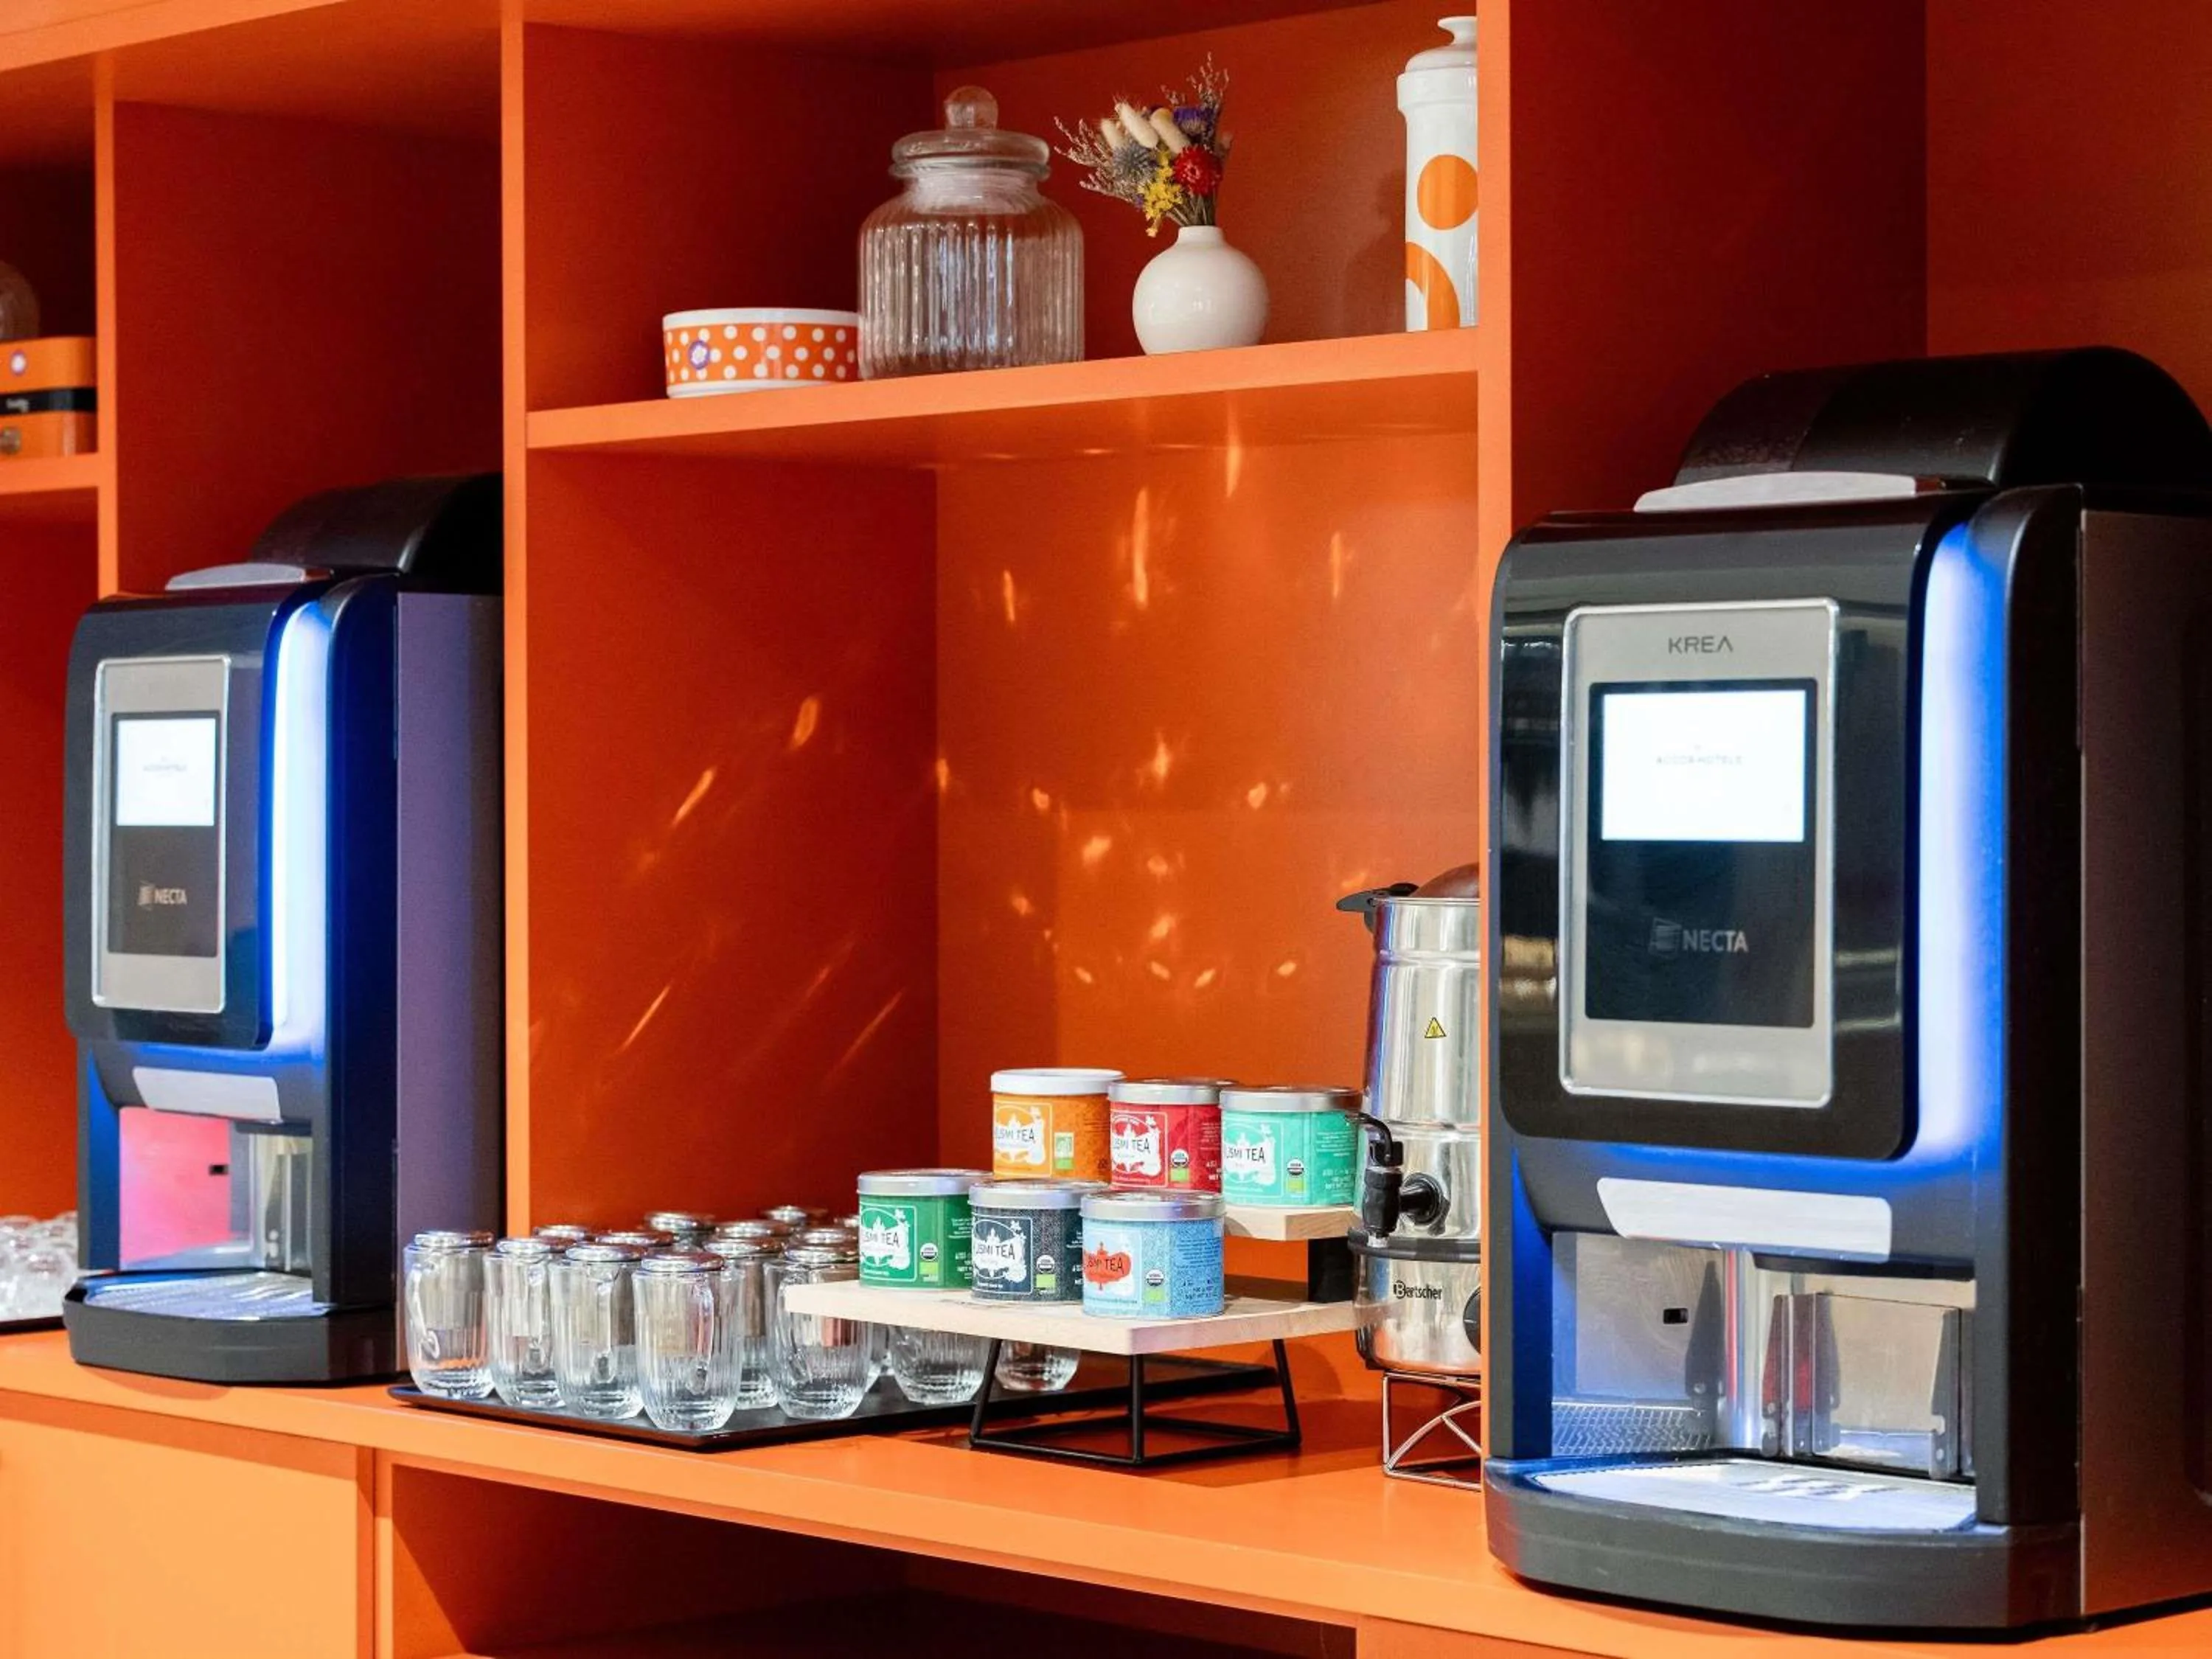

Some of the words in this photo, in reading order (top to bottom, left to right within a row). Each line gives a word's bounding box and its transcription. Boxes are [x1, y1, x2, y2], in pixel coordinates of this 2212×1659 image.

[1668, 636, 1733, 654] KREA
[155, 888, 187, 905] NECTA
[1683, 929, 1749, 953] NECTA
[1016, 1127, 1036, 1144] TEA
[1132, 1138, 1151, 1155] TEA
[1245, 1147, 1266, 1164] TEA
[881, 1231, 900, 1248] TEA
[995, 1243, 1015, 1260] TEA
[1105, 1256, 1124, 1274] TEA
